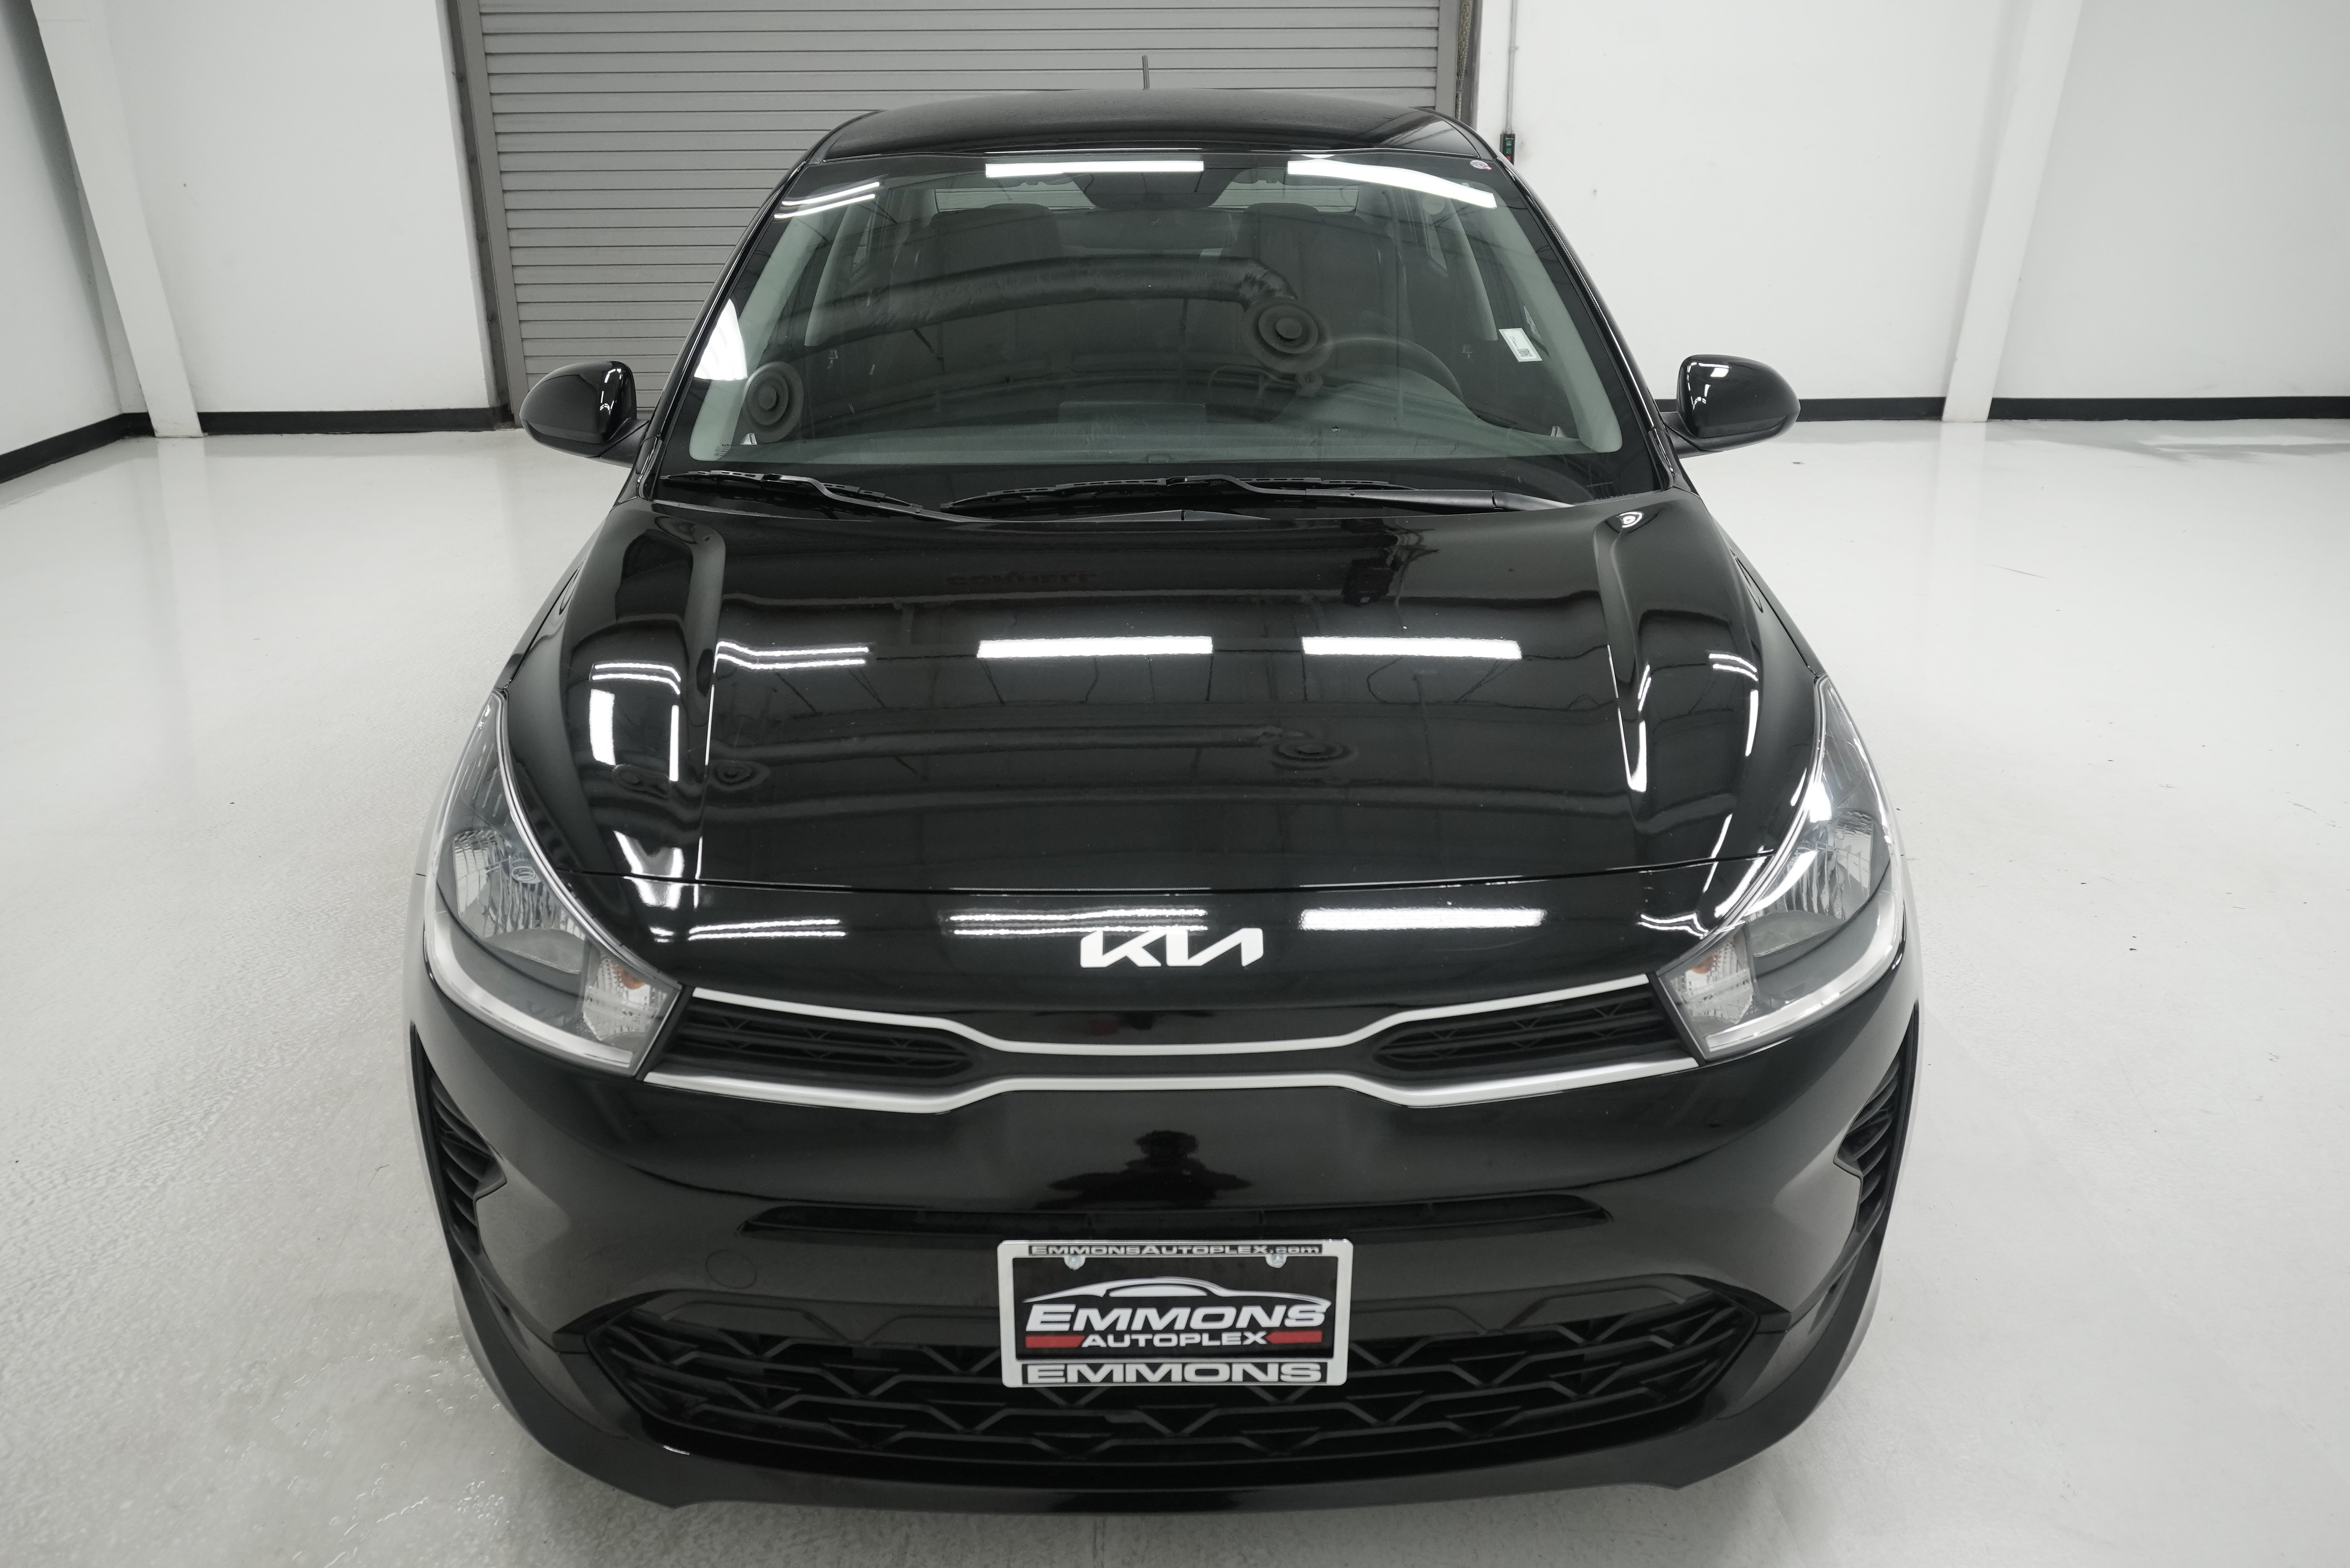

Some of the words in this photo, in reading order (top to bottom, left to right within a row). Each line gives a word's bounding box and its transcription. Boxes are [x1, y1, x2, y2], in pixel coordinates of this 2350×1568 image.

[1080, 928, 1264, 968] KIA
[1026, 1304, 1326, 1331] EMMONS
[1081, 1331, 1268, 1347] AUTOPLEX
[1027, 1363, 1322, 1383] EMMONS
